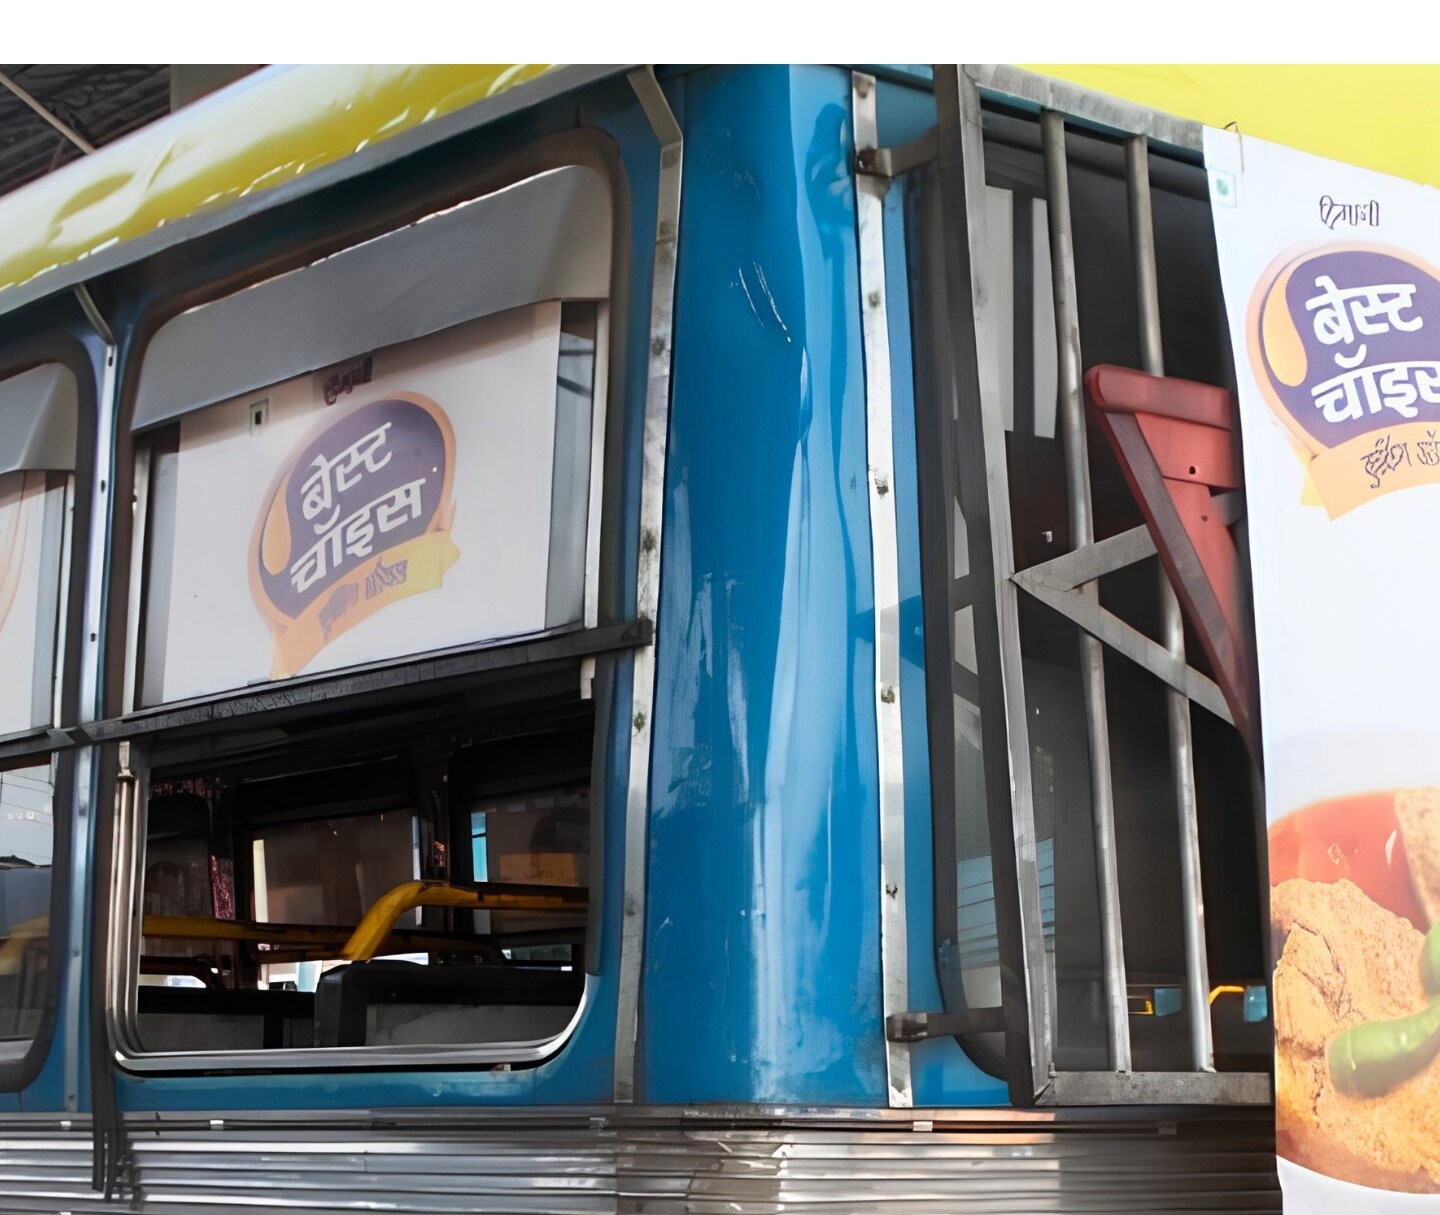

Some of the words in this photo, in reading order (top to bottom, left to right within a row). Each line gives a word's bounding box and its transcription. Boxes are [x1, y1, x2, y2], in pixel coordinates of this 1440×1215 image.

[1305, 275, 1423, 345] बेस्ट
[301, 422, 392, 521] बेस्ट
[291, 477, 427, 594] चॉइस
